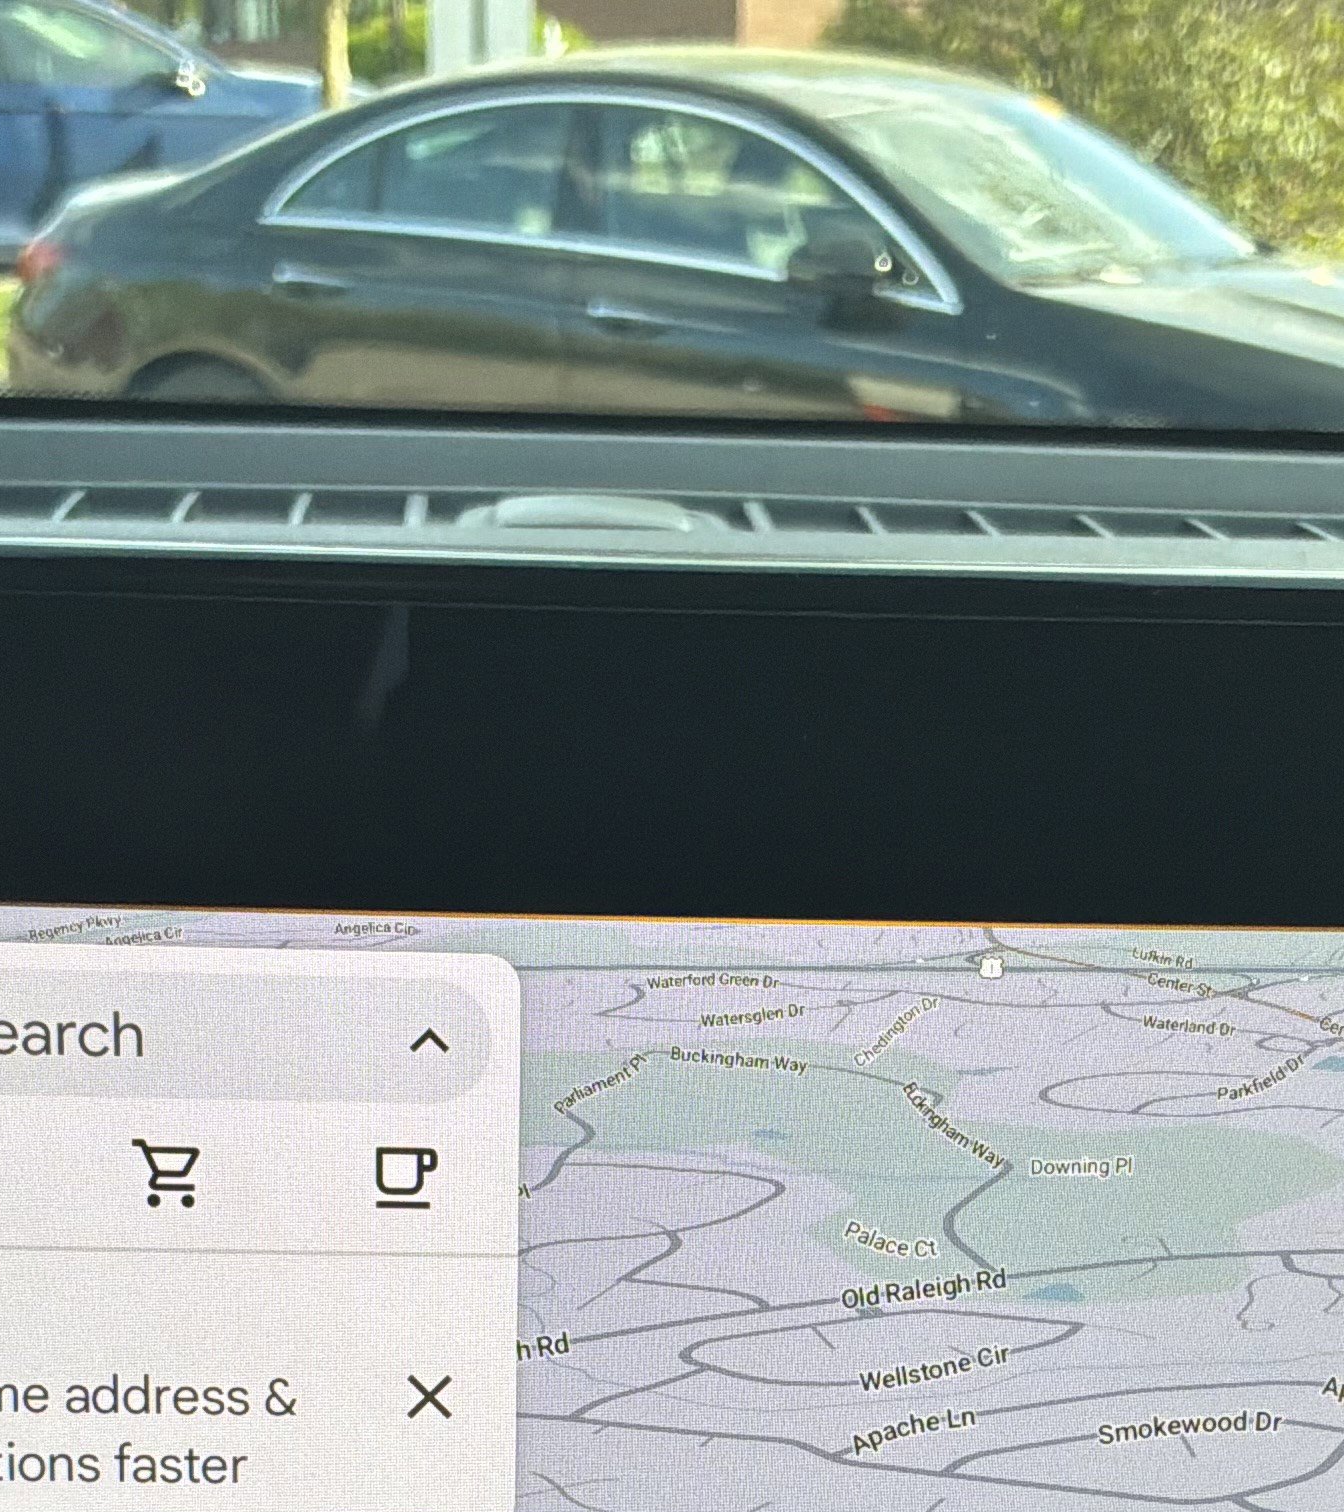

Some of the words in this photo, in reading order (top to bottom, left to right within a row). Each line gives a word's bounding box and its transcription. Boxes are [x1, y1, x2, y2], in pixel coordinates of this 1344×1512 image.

[164, 926, 183, 941] Cir
[1175, 955, 1193, 969] Rd
[646, 973, 715, 991] Waterford
[719, 974, 758, 987] Green
[762, 975, 780, 989] Dr
[1147, 973, 1193, 993] Center
[1196, 984, 1212, 998] St
[700, 1007, 782, 1028] Watersglen
[786, 1003, 805, 1017] Dr
[1143, 1016, 1215, 1034] Waterland
[1219, 1022, 1236, 1036] Dr
[854, 1003, 922, 1068] Chedington
[920, 996, 939, 1012] Dr
[670, 1047, 769, 1069] Buckingham
[774, 1056, 808, 1076] Way
[1217, 1066, 1287, 1100] Parkfield
[1286, 1054, 1305, 1073] Dr
[554, 1066, 633, 1114] Parliament
[629, 1053, 648, 1072] Pl
[971, 1140, 1005, 1169] Way
[1030, 1158, 1110, 1177] Downing
[1114, 1157, 1132, 1174] Pl
[844, 1221, 909, 1257] Palace
[914, 1239, 937, 1257] Ct
[842, 1284, 880, 1309] Old
[886, 1274, 970, 1302] Raleigh
[976, 1268, 1007, 1289] Rd
[537, 1333, 570, 1355] Rd
[860, 1357, 972, 1391] Wellstone
[977, 1346, 1009, 1367] Cir
[65, 1375, 249, 1416] address
[265, 1378, 297, 1416] &
[852, 1415, 940, 1454] Apache
[946, 1409, 976, 1428] Ln
[1098, 1411, 1248, 1445] Smokewood
[1255, 1412, 1283, 1431] Dr
[113, 1442, 247, 1485] faster
